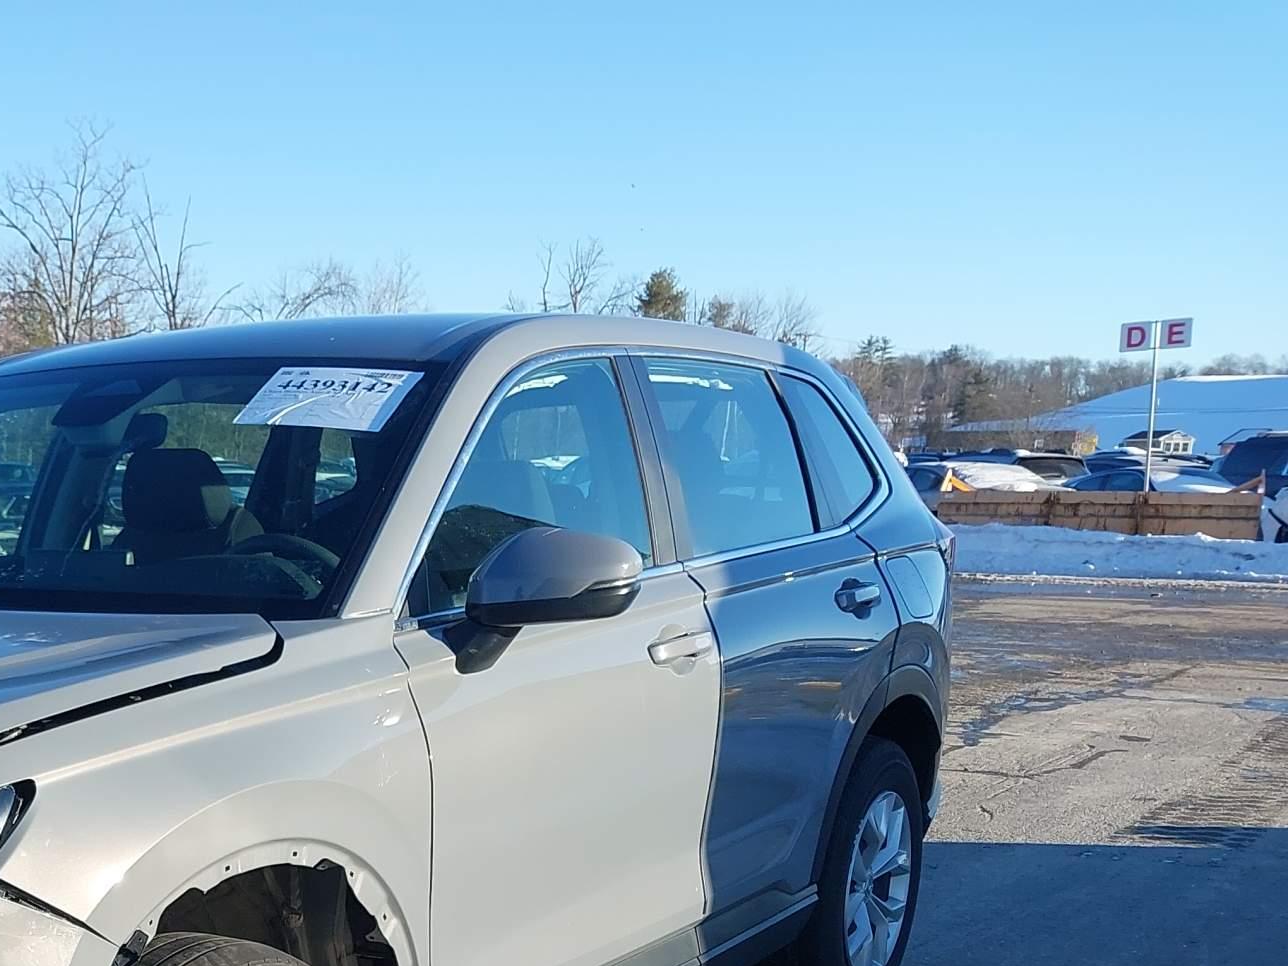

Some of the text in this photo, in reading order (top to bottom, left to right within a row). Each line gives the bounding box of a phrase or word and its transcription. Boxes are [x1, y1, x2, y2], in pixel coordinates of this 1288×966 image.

[1126, 326, 1146, 348] D
[1167, 322, 1186, 345] E
[277, 378, 394, 395] 44393142
